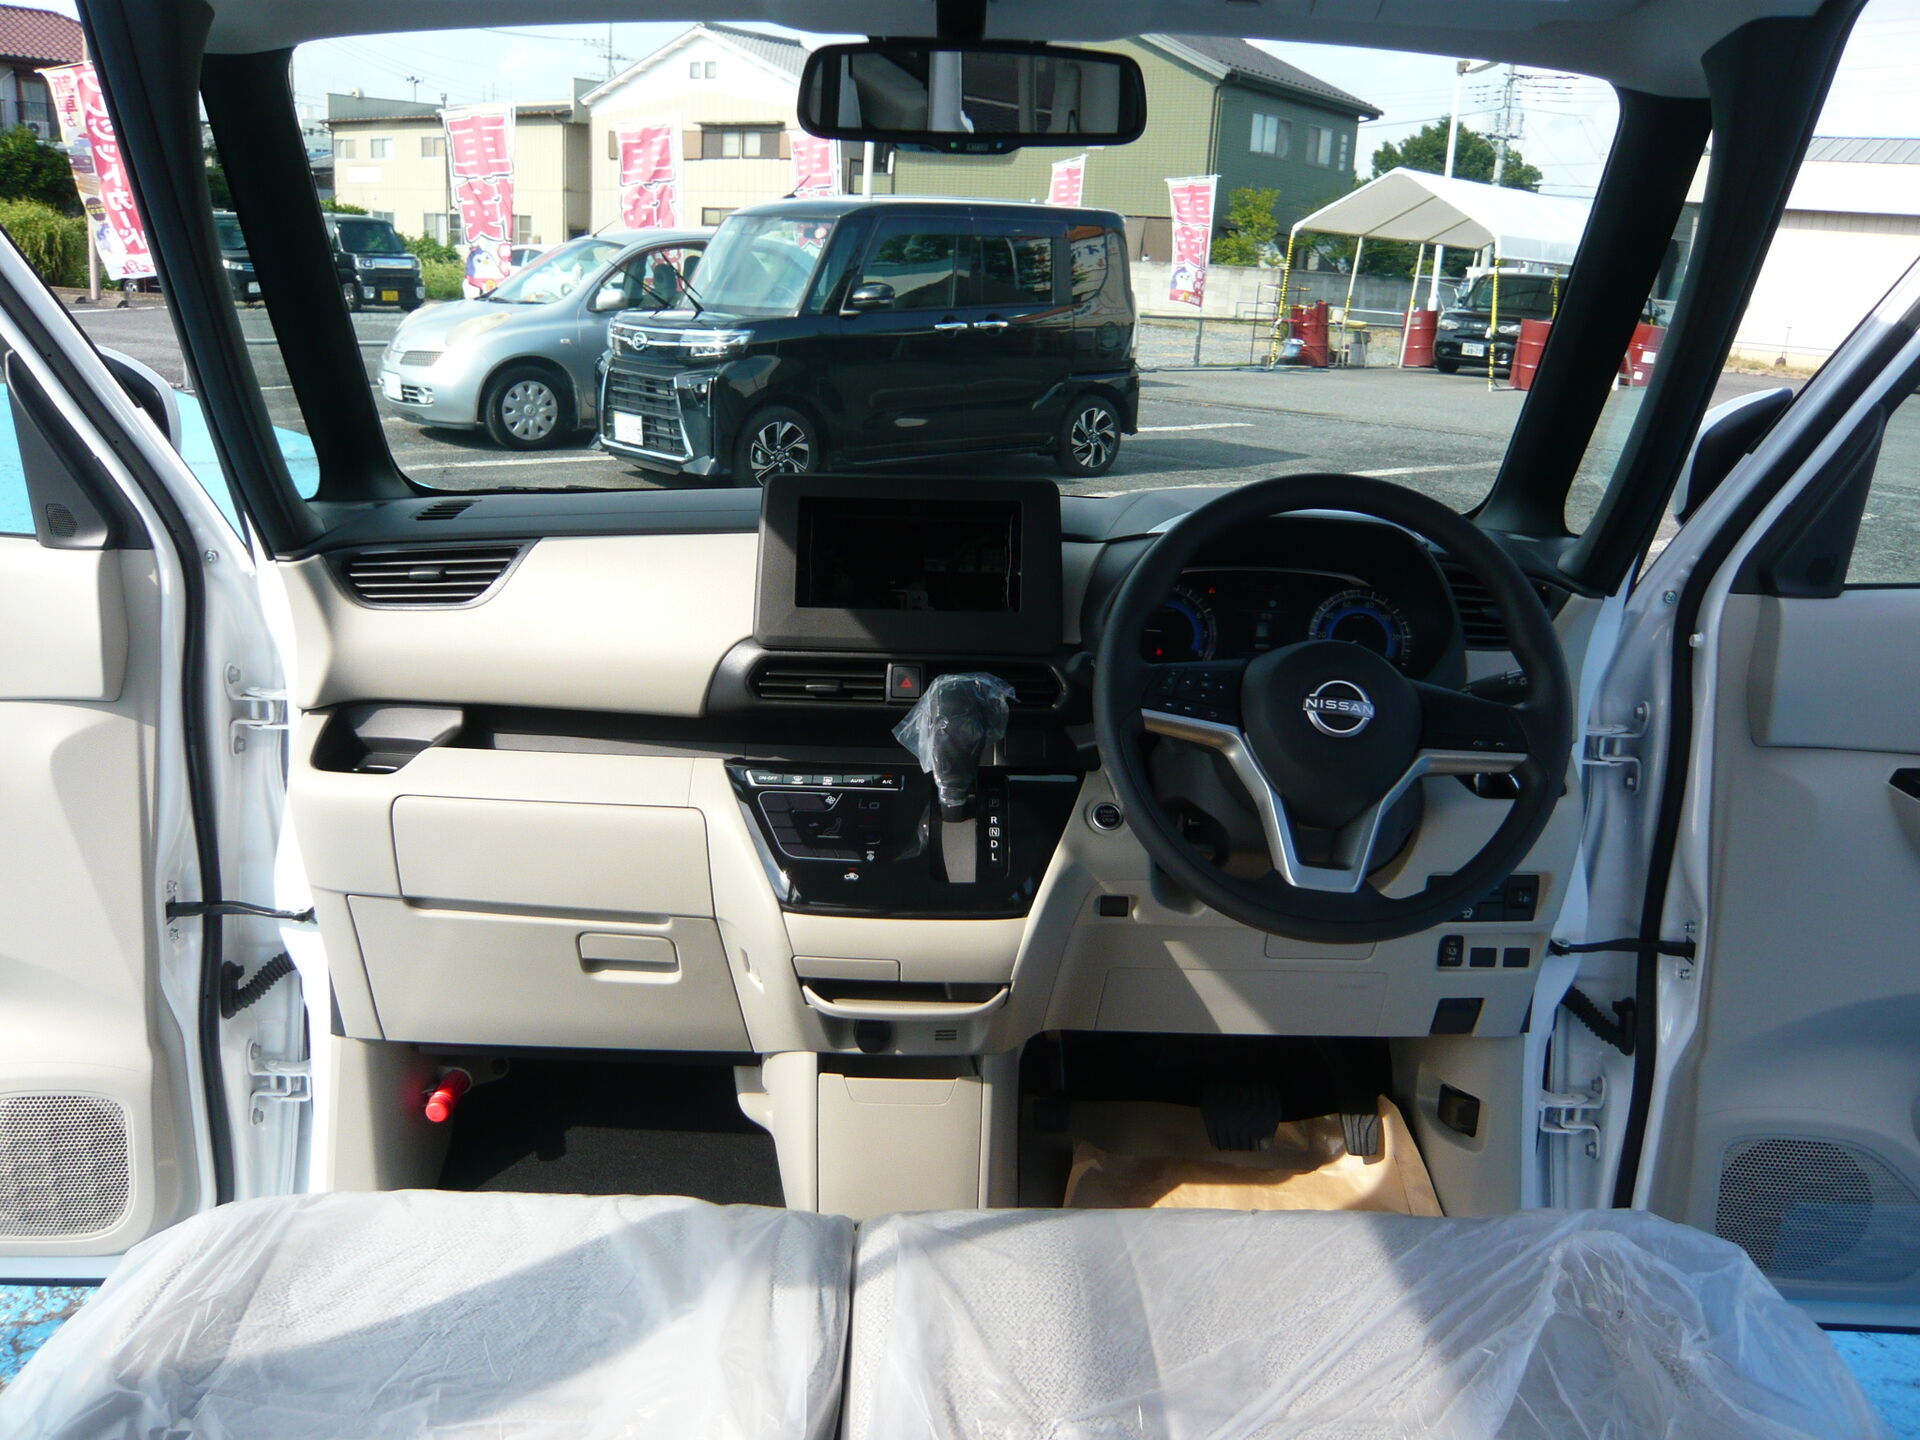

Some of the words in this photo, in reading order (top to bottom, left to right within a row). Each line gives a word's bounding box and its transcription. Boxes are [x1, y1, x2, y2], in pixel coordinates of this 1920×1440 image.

[1305, 698, 1374, 715] NISSAN
[990, 816, 998, 824] R
[990, 840, 999, 848] D
[991, 852, 998, 861] L
